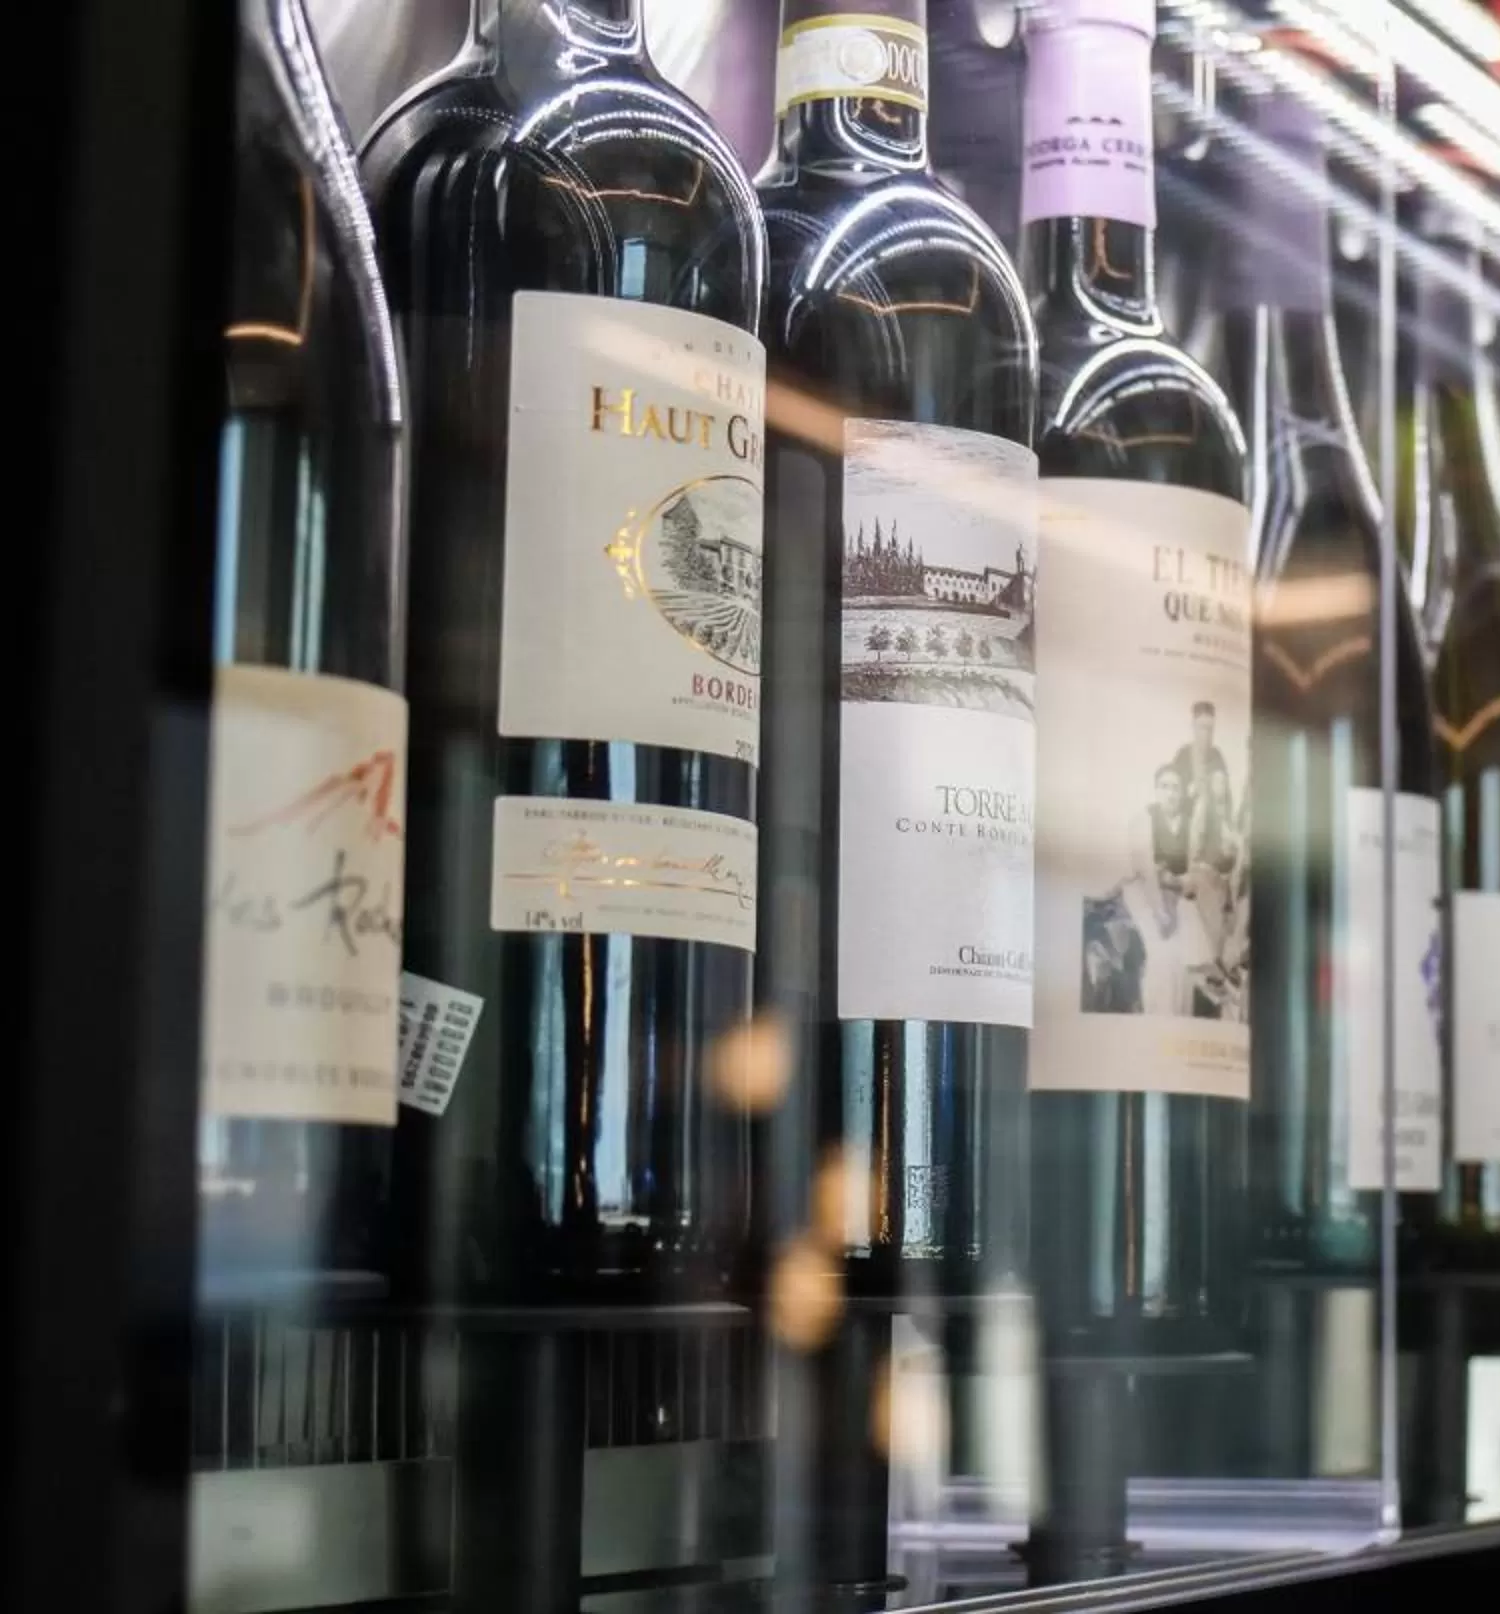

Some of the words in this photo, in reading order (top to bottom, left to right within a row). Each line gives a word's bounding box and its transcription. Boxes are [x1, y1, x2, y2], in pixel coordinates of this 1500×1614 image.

[591, 384, 715, 450] HAUT
[727, 414, 763, 472] GR
[1164, 591, 1212, 624] QUE
[692, 673, 758, 710] BORDE
[936, 785, 1017, 823] TORRE
